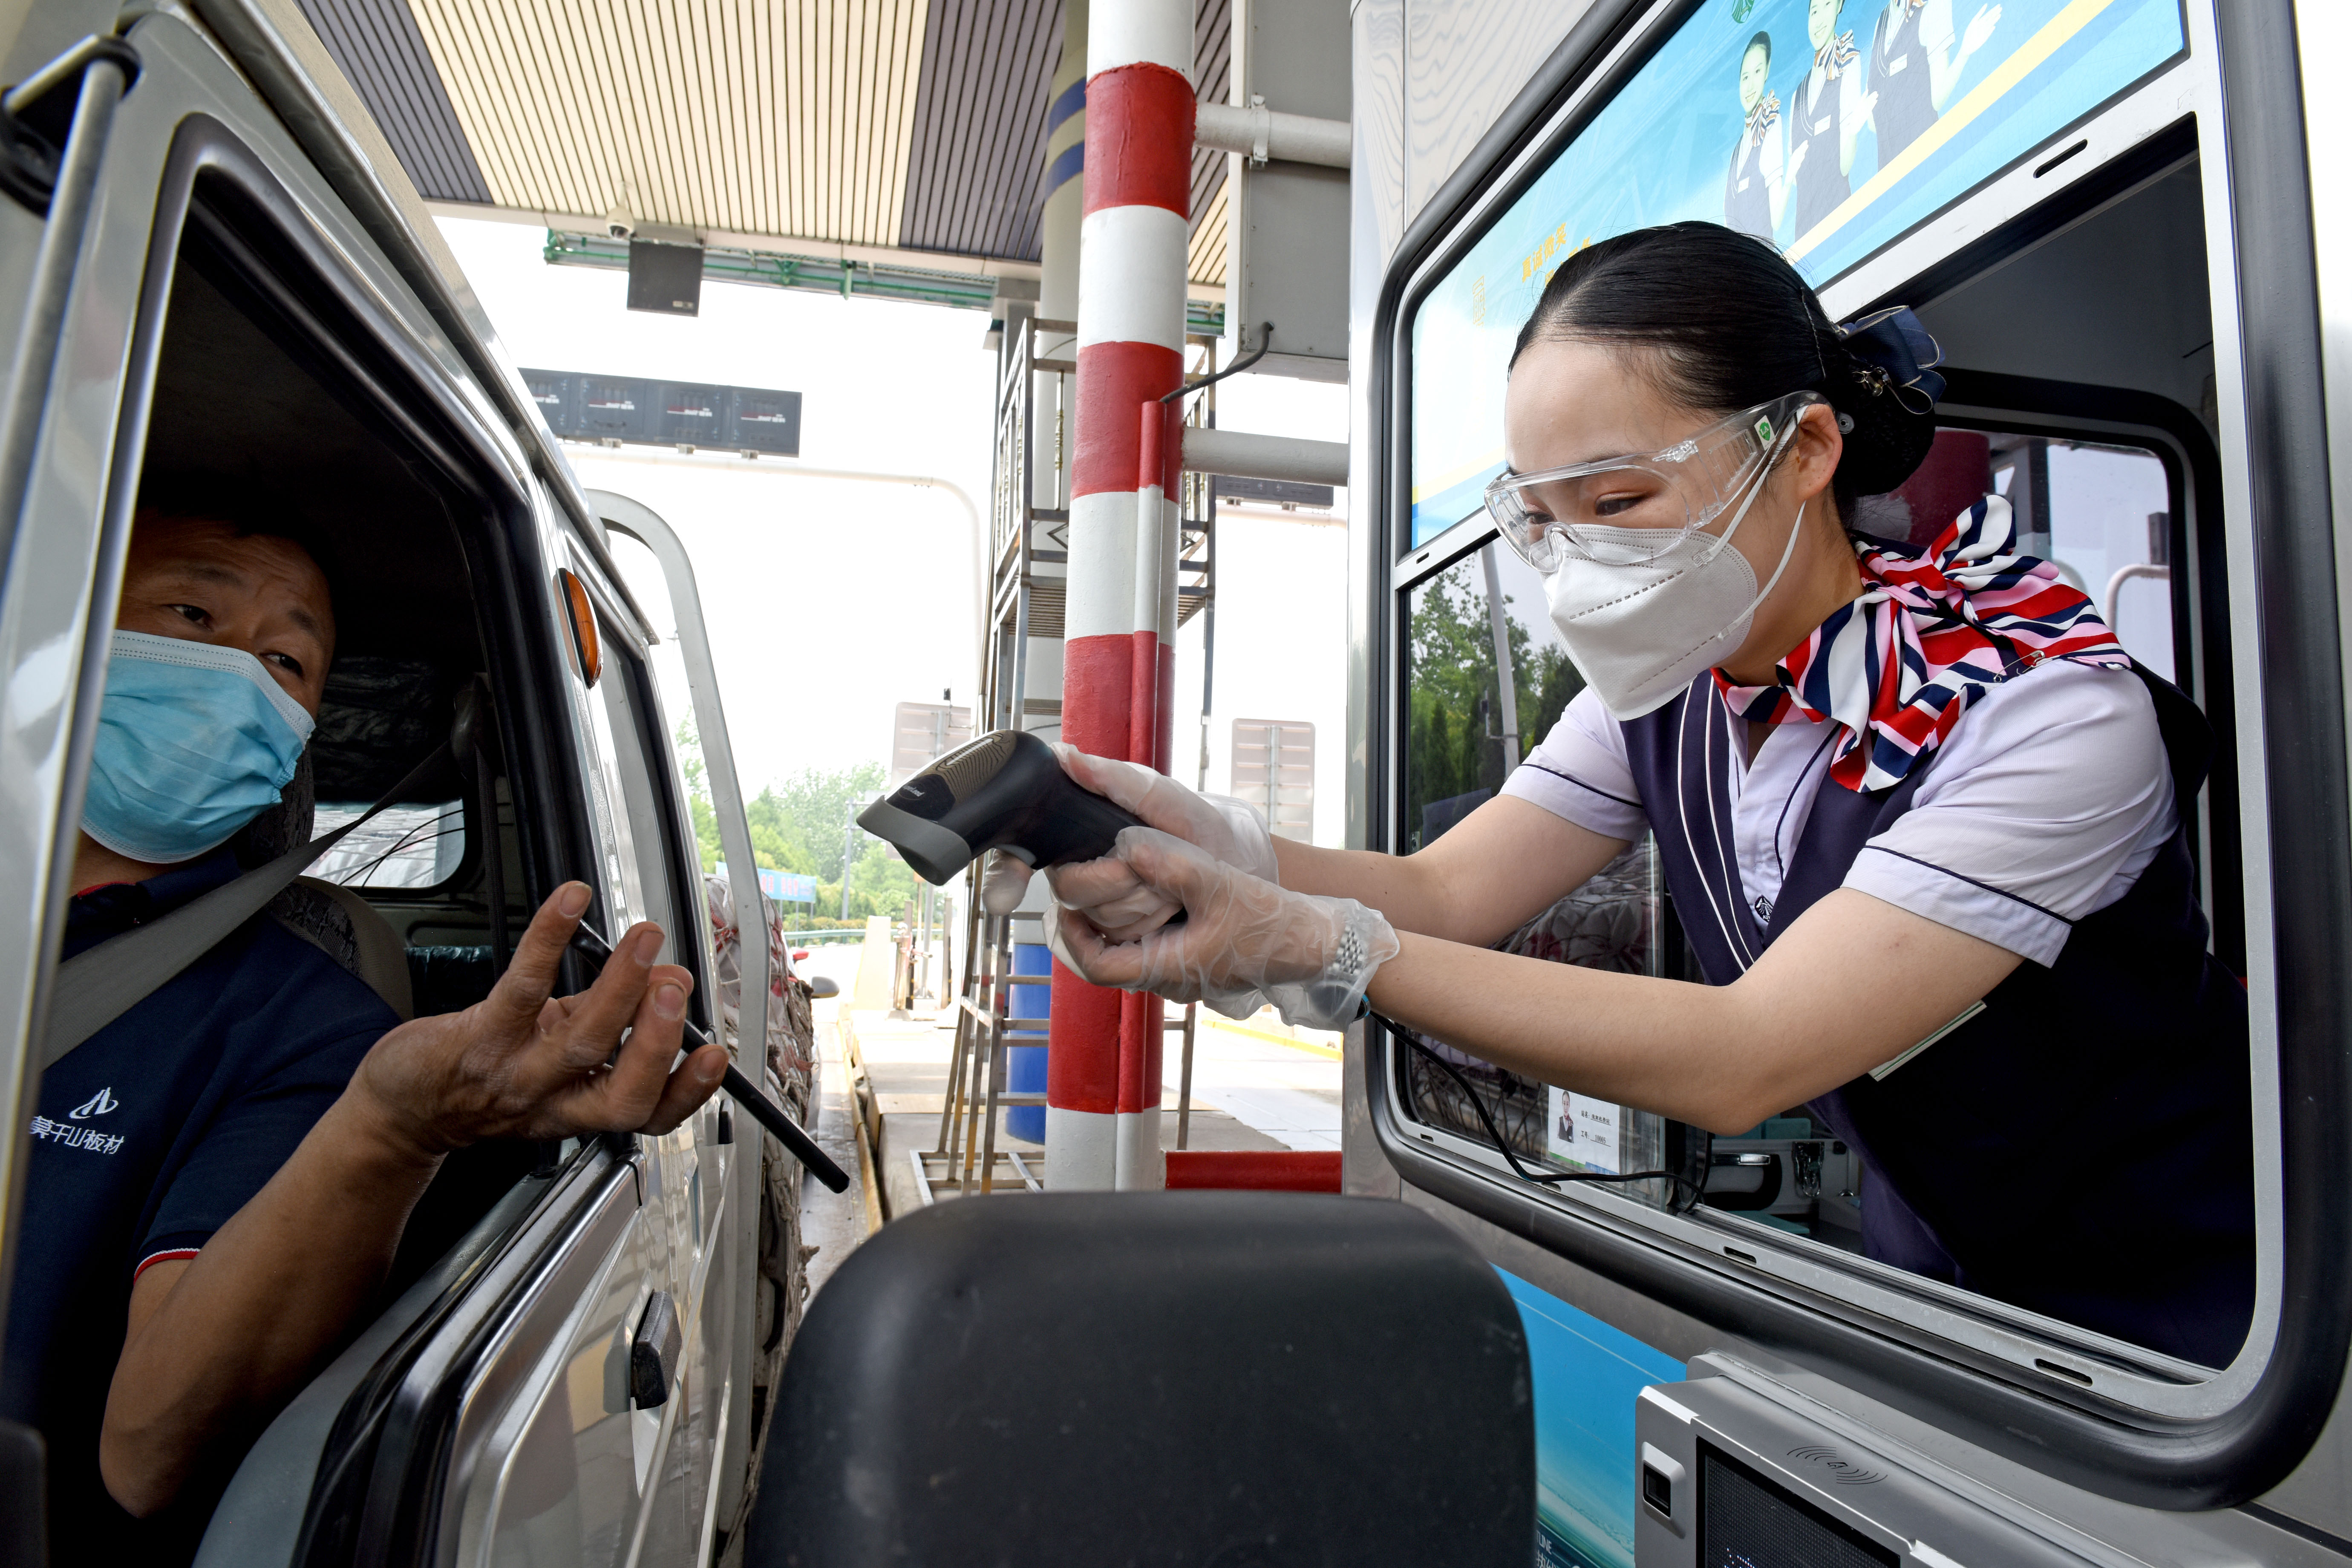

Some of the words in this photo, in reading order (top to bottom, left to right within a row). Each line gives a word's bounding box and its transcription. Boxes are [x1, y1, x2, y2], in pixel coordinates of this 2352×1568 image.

[29, 1115, 124, 1154] 莫干山板材
[1595, 1134, 1606, 1144] 10005
